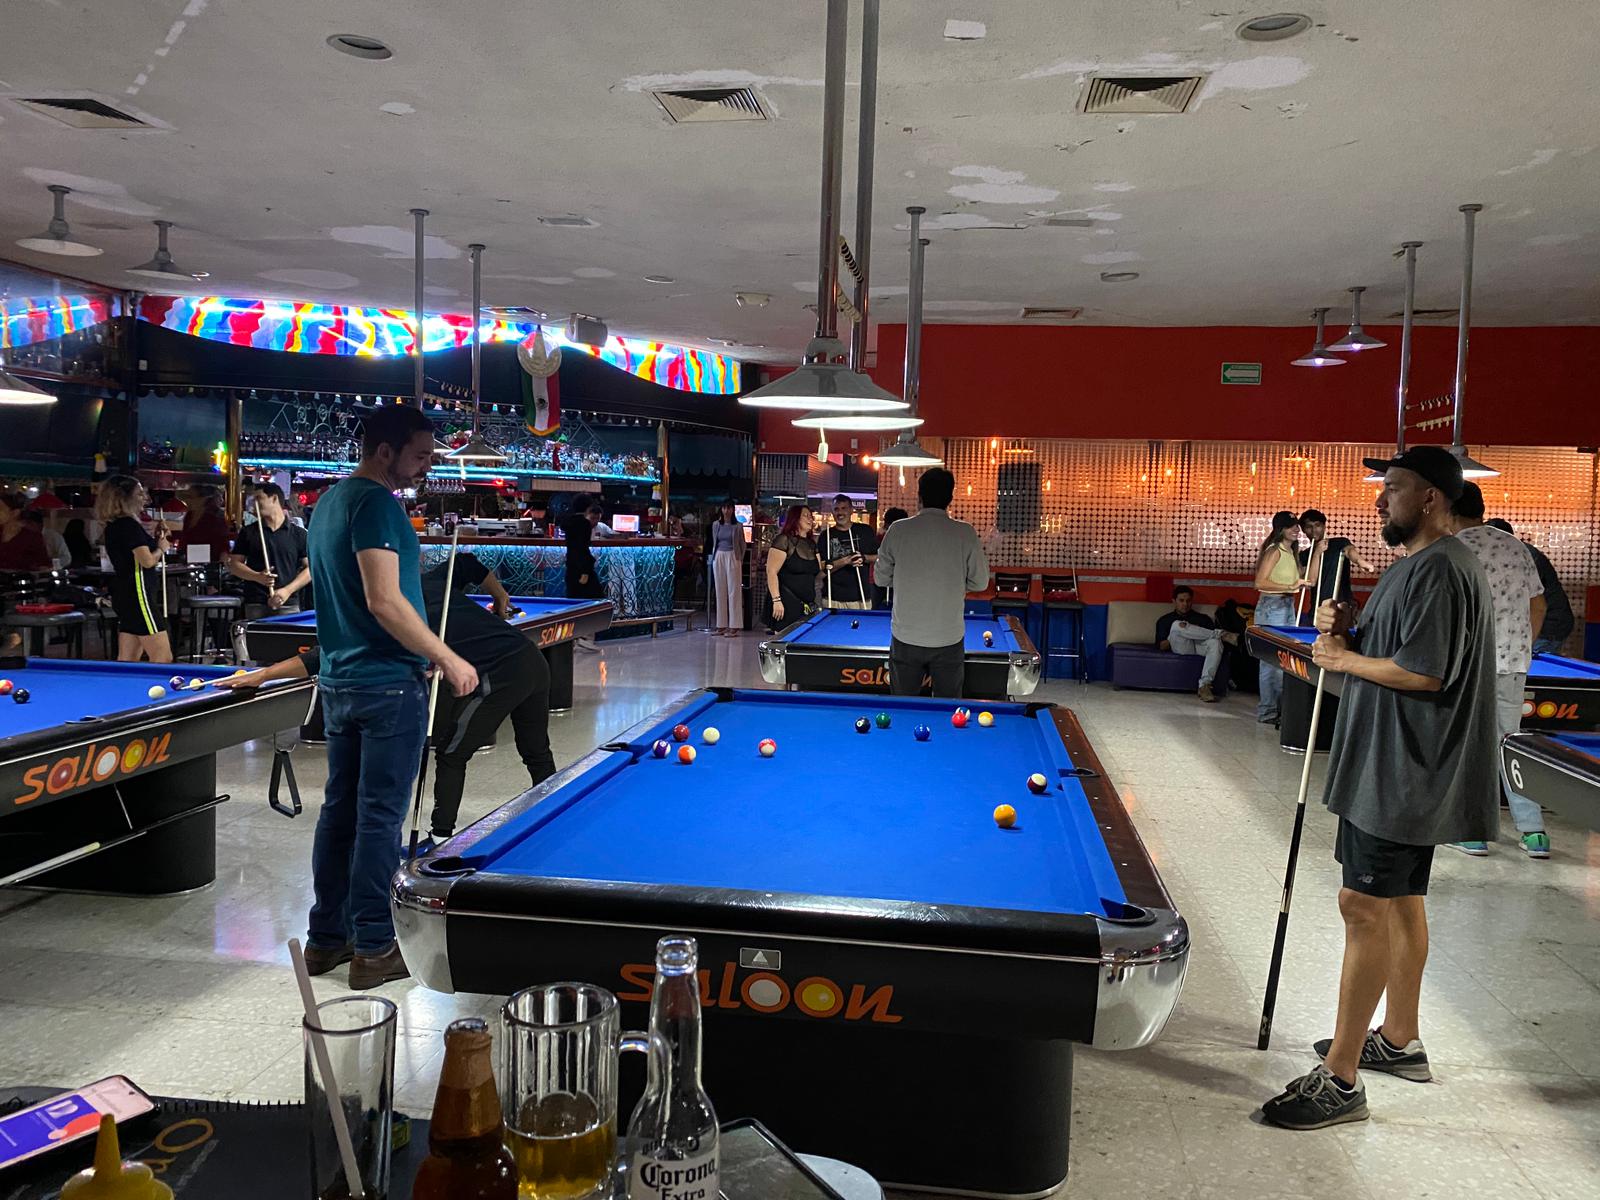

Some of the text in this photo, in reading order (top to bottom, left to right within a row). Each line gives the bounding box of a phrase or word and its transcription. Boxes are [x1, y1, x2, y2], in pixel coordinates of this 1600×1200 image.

[14, 732, 173, 805] saloon
[1510, 759, 1524, 790] 6
[640, 1161, 716, 1192] Corona
